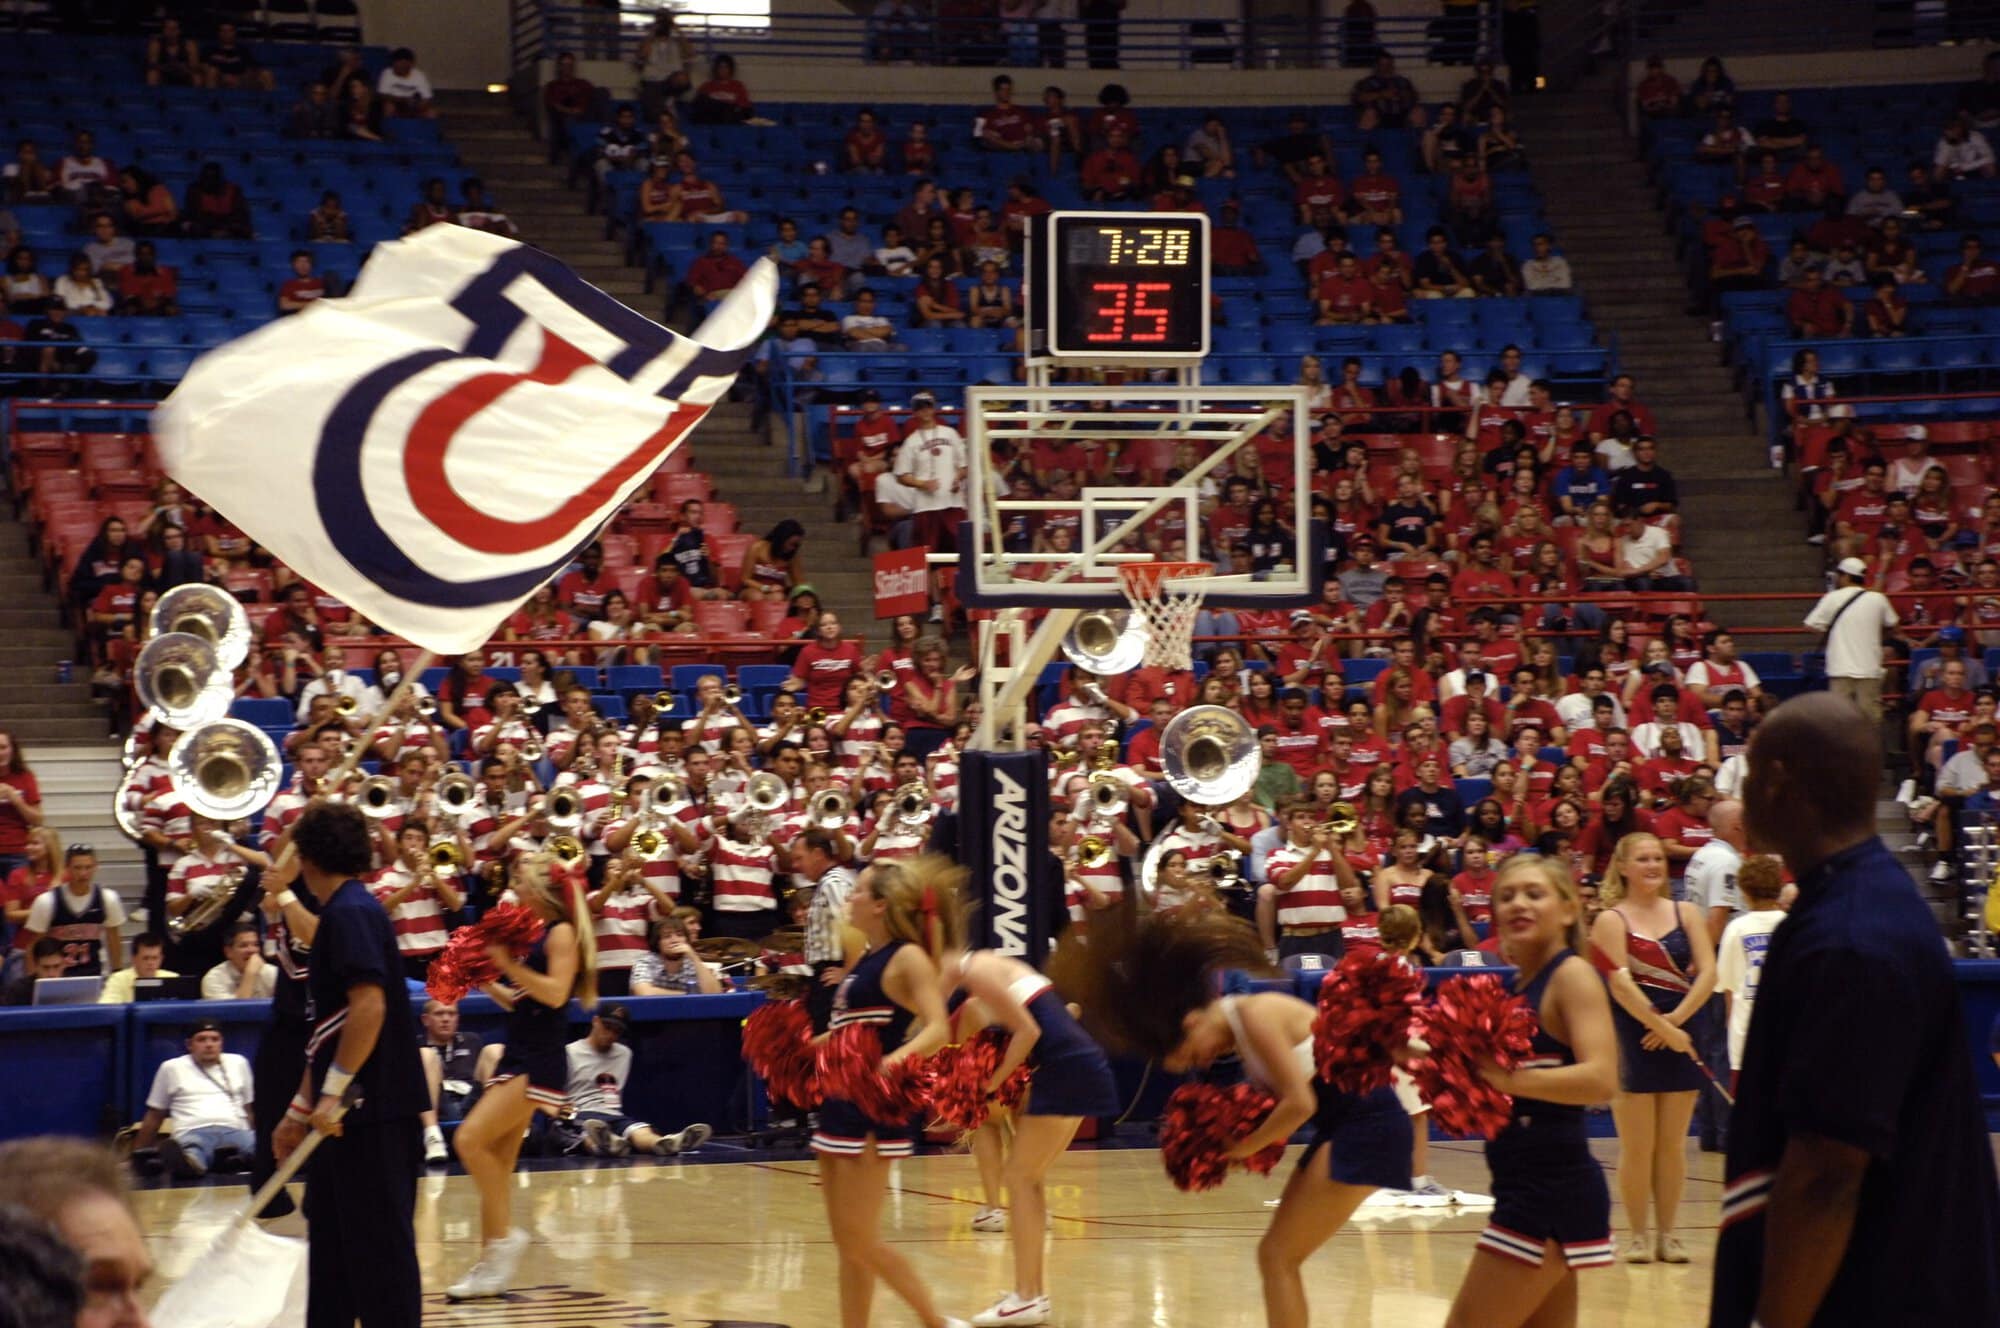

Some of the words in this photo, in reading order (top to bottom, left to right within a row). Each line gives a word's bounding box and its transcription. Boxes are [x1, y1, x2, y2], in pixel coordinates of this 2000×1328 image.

[1099, 229, 1191, 265] 7:28
[1088, 282, 1171, 342] 35
[993, 767, 1027, 957] ARIZONA
